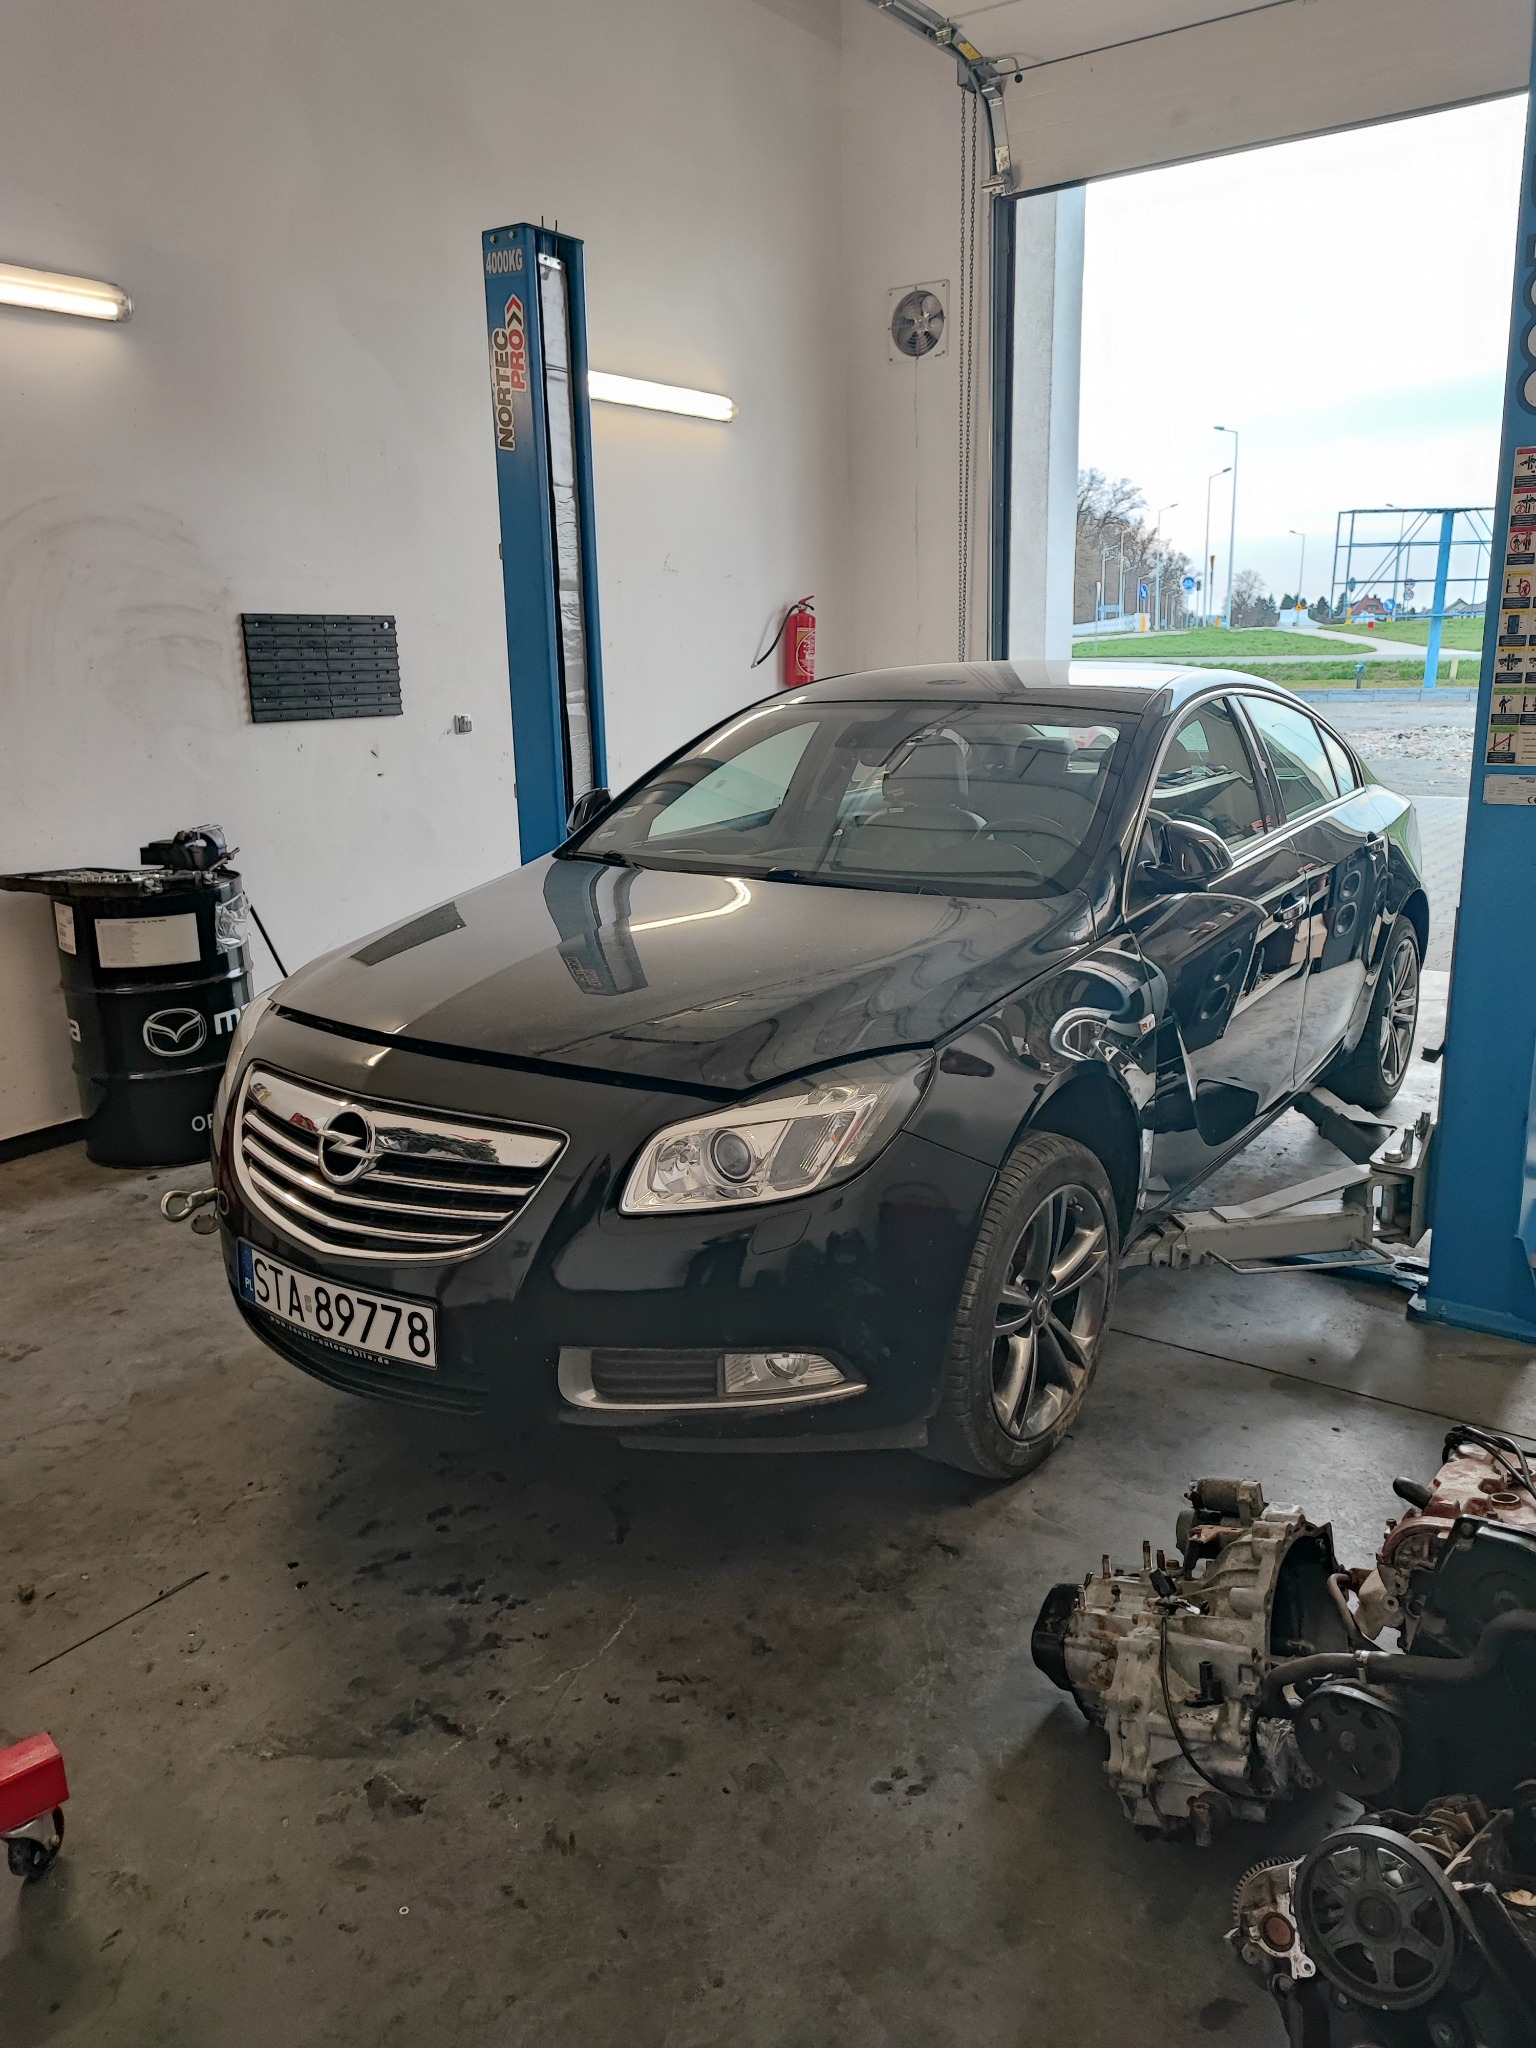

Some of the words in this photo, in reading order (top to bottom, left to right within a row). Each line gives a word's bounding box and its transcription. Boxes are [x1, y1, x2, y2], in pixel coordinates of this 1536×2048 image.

[485, 247, 523, 274] 4000KG
[493, 329, 515, 449] NORTEC
[508, 329, 526, 390] PRO
[244, 1276, 254, 1292] PL
[254, 1258, 305, 1323] STA
[314, 1286, 431, 1358] 89778
